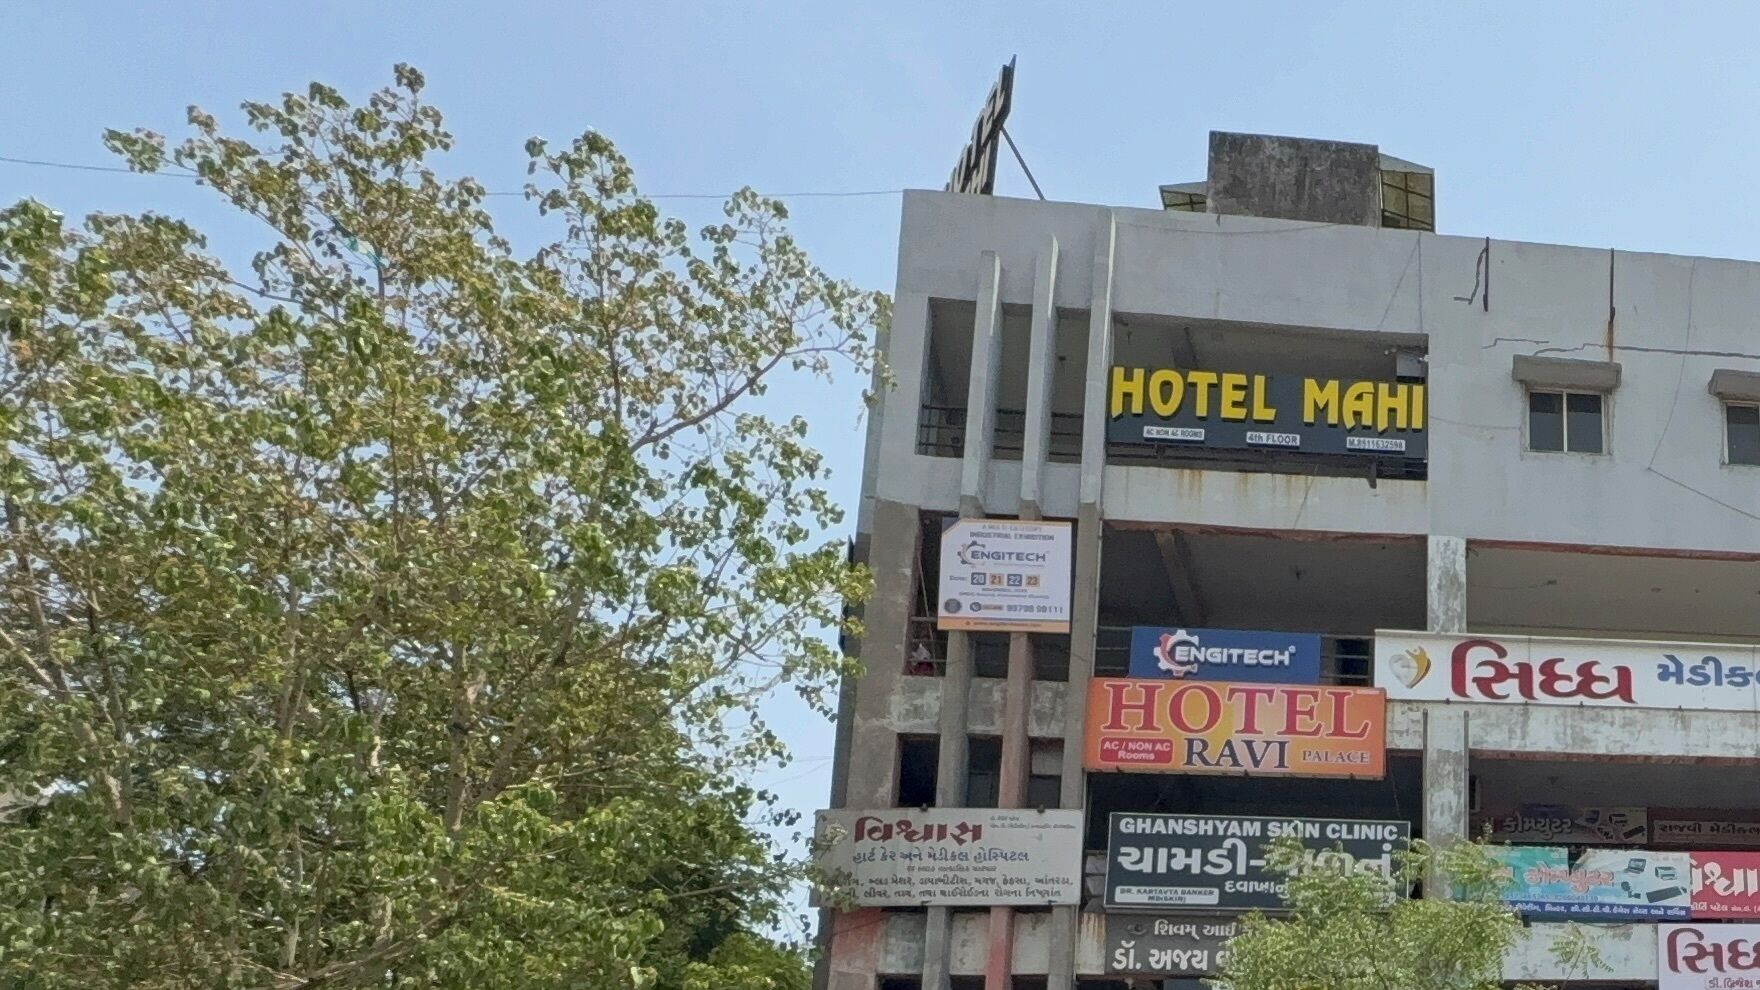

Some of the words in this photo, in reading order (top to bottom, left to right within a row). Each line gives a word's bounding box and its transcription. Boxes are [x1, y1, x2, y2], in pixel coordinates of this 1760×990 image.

[1112, 367, 1276, 421] HOTEL
[1303, 378, 1424, 433] MAHI
[1266, 434, 1298, 446] FLOOR
[970, 550, 1047, 562] ENGITECH
[1175, 645, 1290, 667] ENGITECH
[1101, 682, 1372, 739] HOTEL
[1104, 741, 1120, 749] AC
[1128, 741, 1153, 751] NON
[1155, 742, 1170, 751] AC
[1118, 751, 1155, 761] Rooms
[1183, 737, 1290, 769] RAVI
[1302, 750, 1370, 764] PALACE
[854, 816, 983, 846] વિશ્વાસ
[1119, 818, 1261, 837] GHANSHYAM
[1267, 821, 1320, 839] SKIN
[1326, 823, 1398, 840] CLINIC
[1149, 948, 1208, 971] અજય
